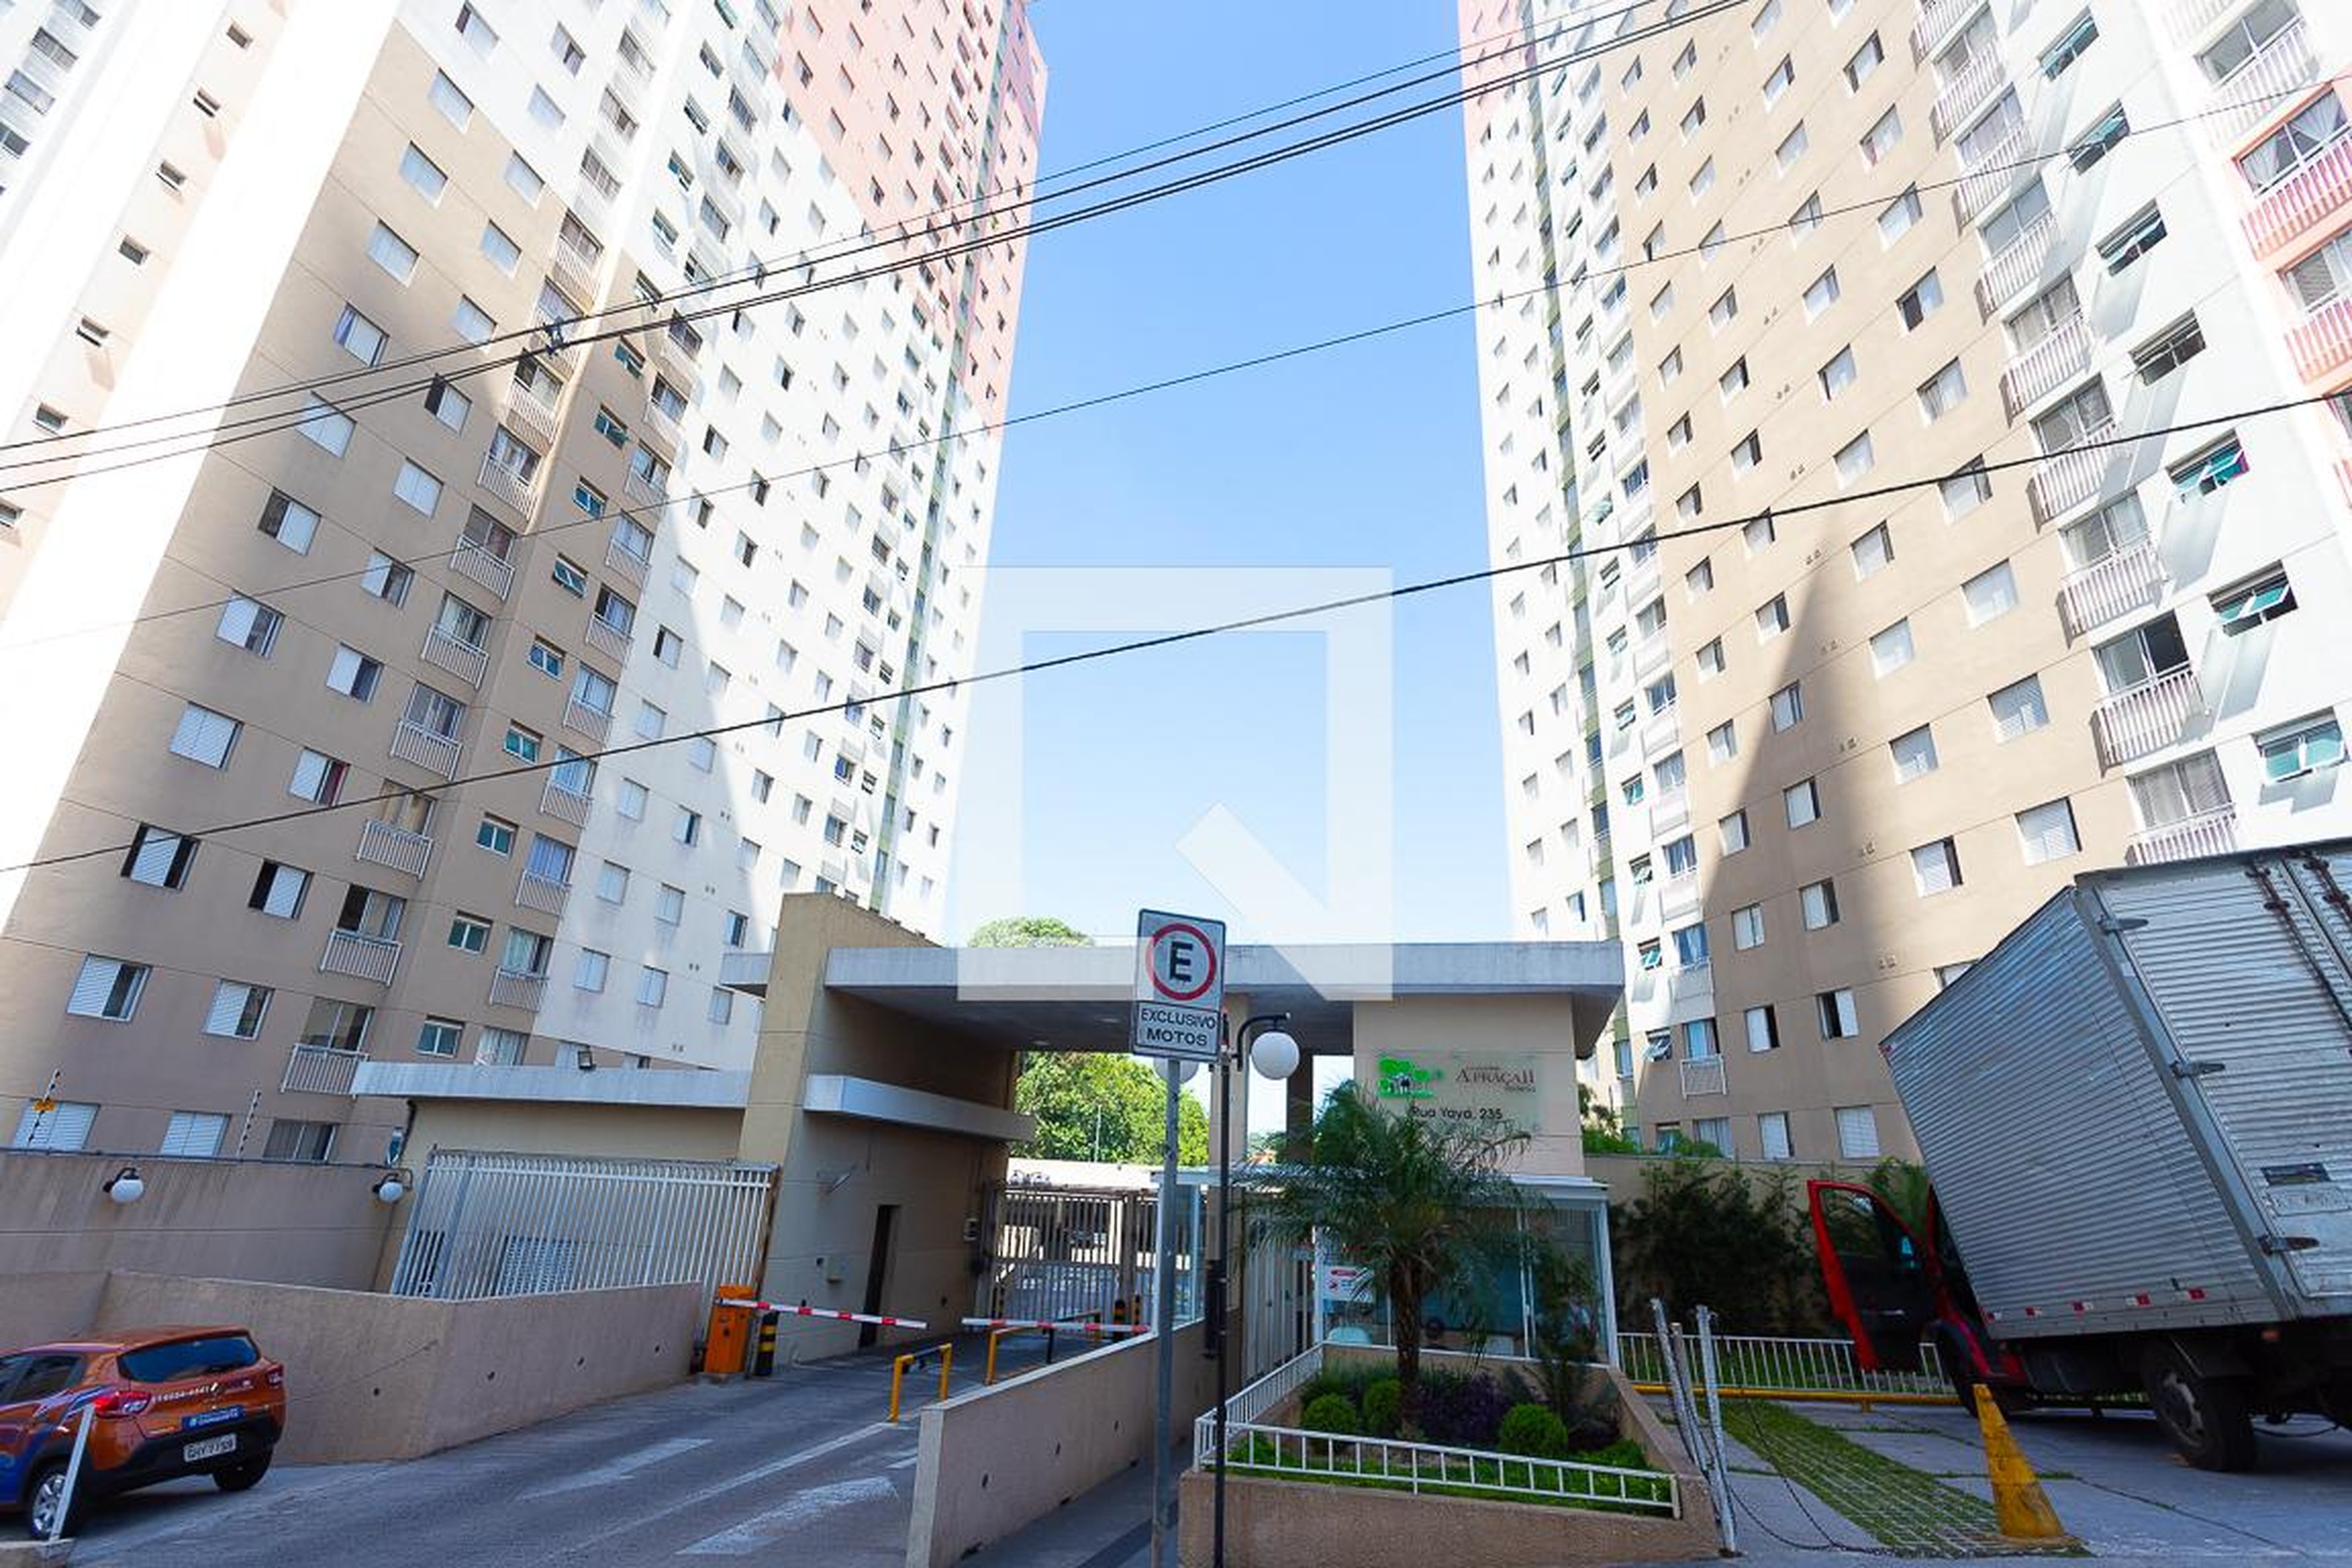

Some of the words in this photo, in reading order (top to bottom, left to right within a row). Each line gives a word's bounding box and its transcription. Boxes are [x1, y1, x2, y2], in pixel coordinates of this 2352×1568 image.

[1169, 941, 1193, 982] E
[1140, 1008, 1216, 1030] EXCLUSIVO
[1146, 1028, 1207, 1046] MOTOS
[1410, 1106, 1436, 1118] Rua
[1479, 1107, 1503, 1120] 235
